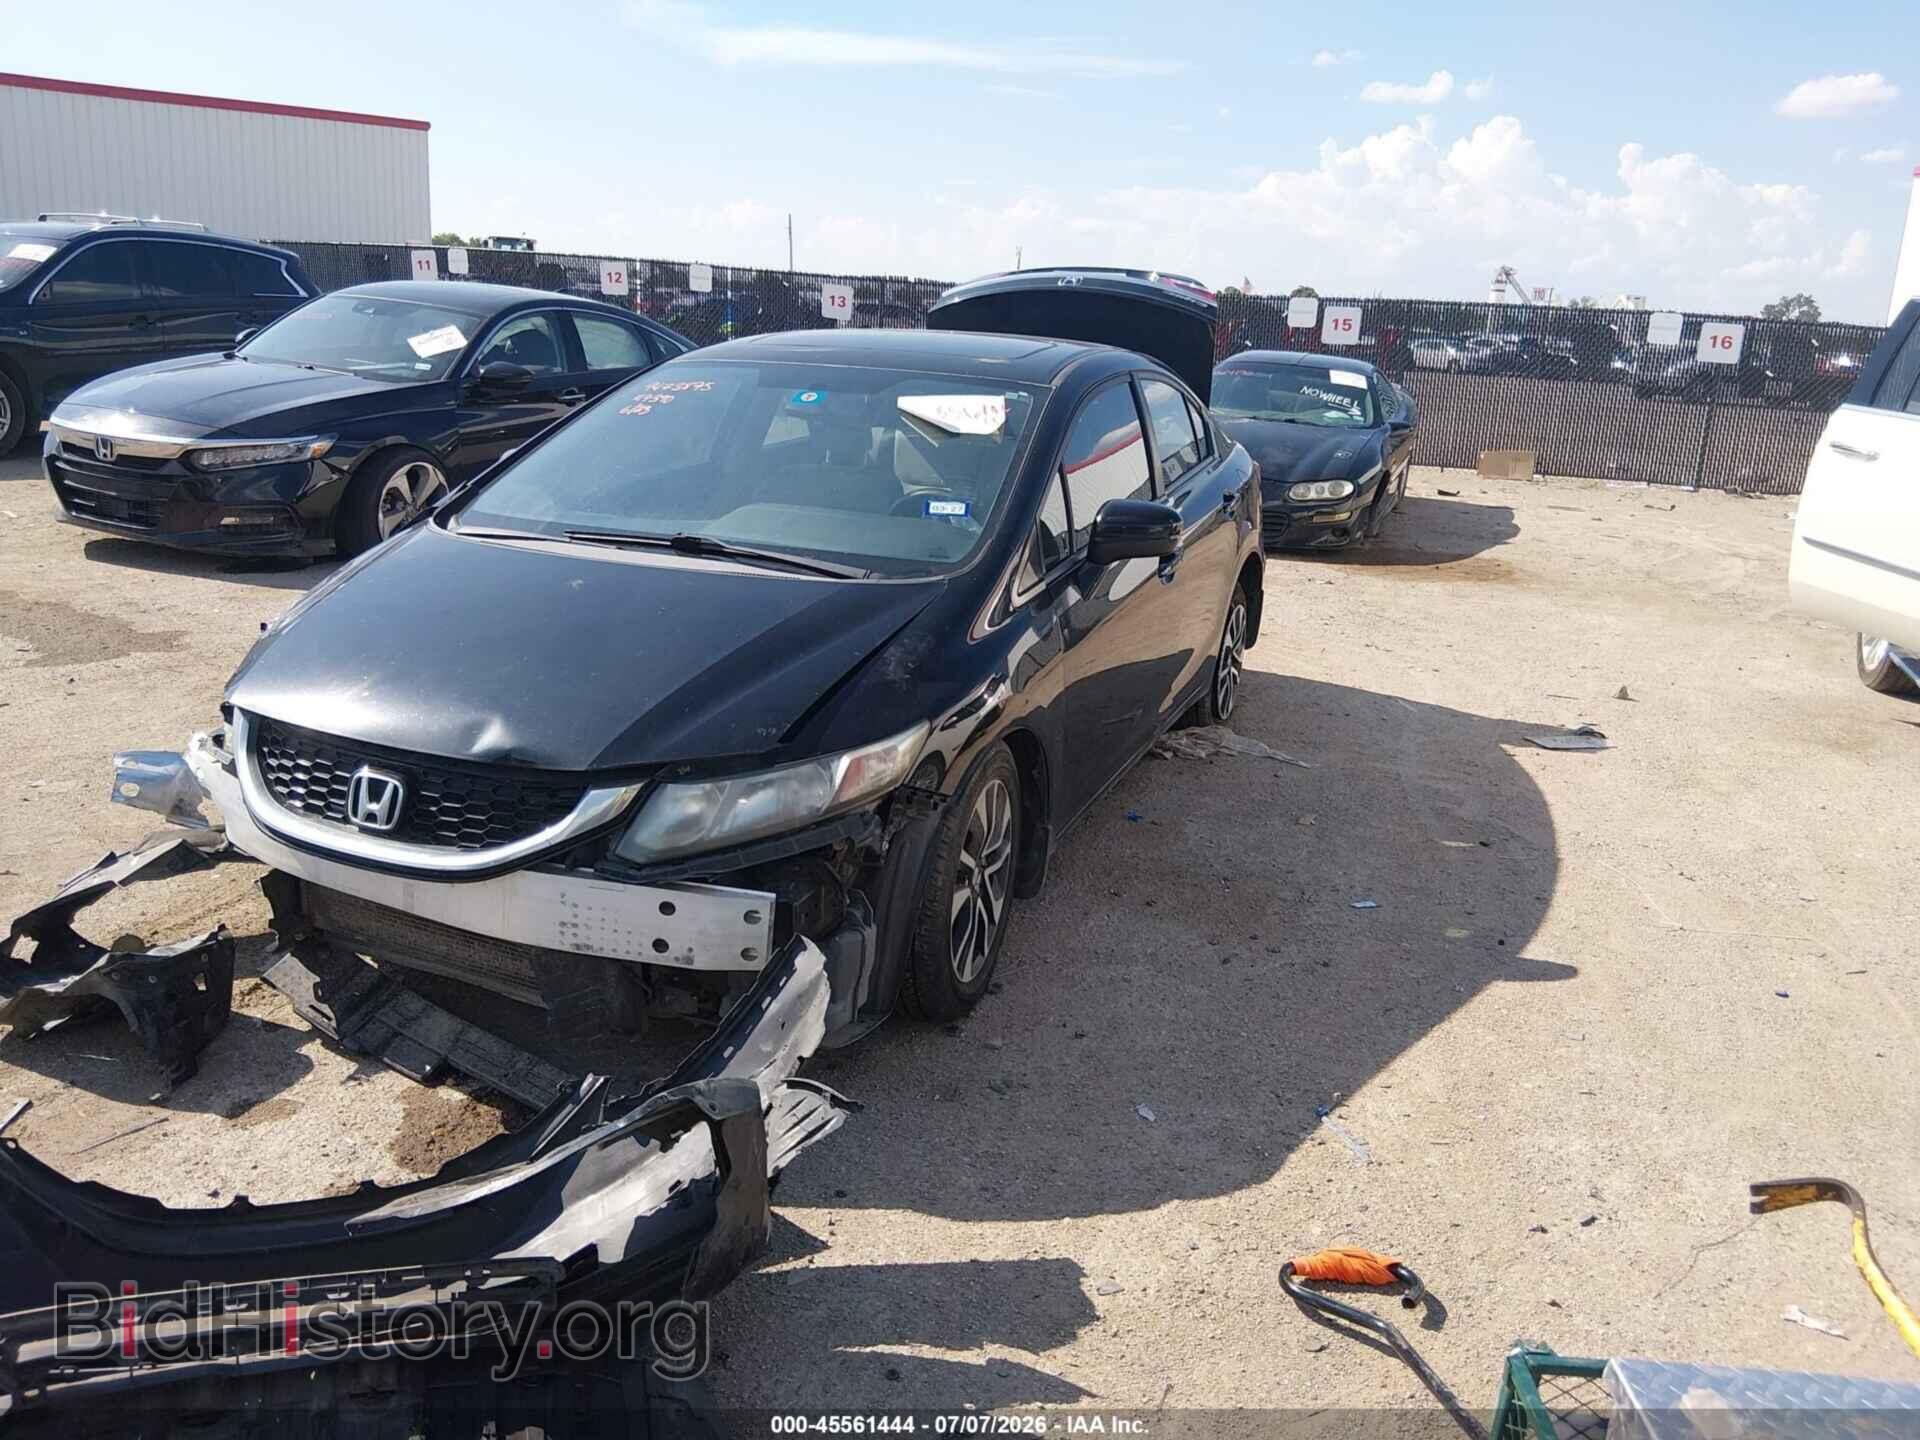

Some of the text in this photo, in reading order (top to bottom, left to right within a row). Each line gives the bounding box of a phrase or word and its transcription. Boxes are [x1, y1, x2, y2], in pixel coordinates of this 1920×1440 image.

[417, 260, 430, 271] 11
[607, 272, 622, 283] 12
[830, 295, 846, 307] 13
[1332, 318, 1353, 331] 15
[1710, 335, 1733, 349] 16
